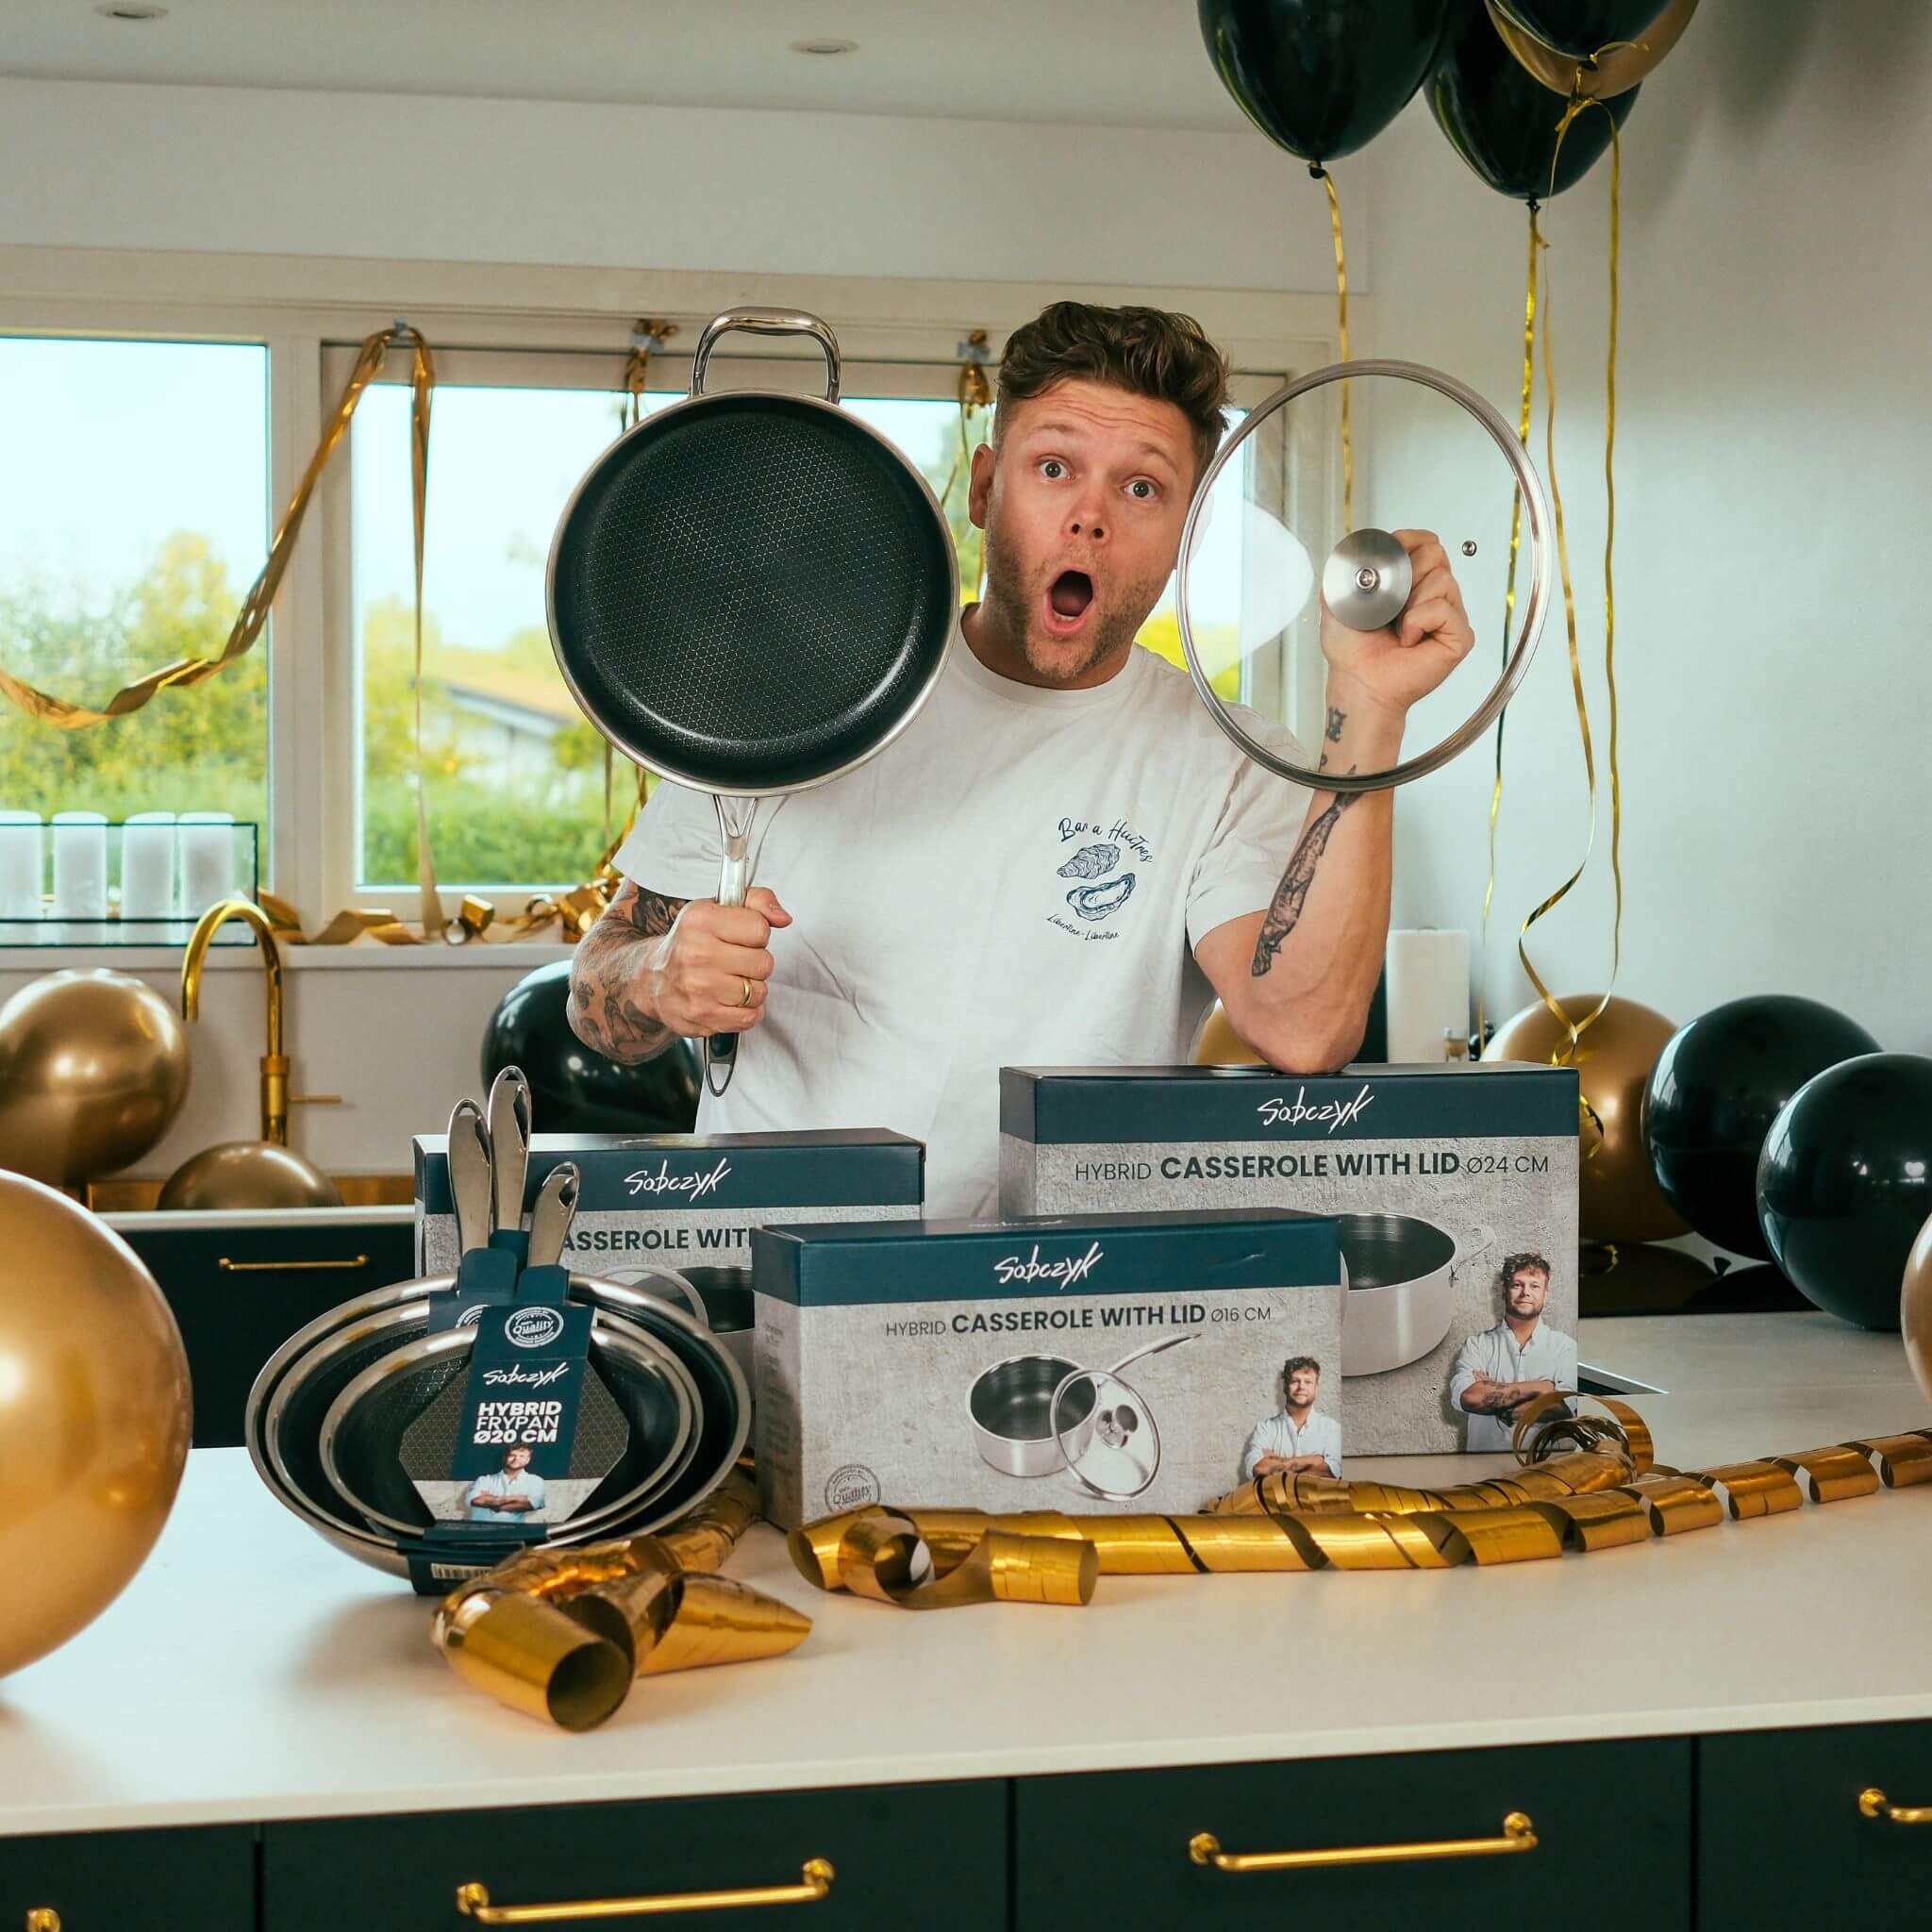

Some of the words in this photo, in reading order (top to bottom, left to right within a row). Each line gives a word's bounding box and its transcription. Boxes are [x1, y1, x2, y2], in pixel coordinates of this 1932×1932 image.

[1058, 817, 1088, 842] Bar
[1257, 1085, 1374, 1134] Sobczyk
[1075, 1163, 1152, 1180] HYBRID
[1160, 1154, 1328, 1179] CASSEROLE
[1335, 1153, 1410, 1176] WITH
[1419, 1152, 1459, 1174] LID
[1514, 1156, 1549, 1173] CM
[624, 1158, 732, 1203] Sobczyk
[563, 1229, 689, 1251] ASSEROLE
[993, 1241, 1104, 1291] Sobczyk
[886, 1320, 947, 1337] HYBRID
[951, 1308, 1093, 1334] CASSEROLE
[1100, 1306, 1164, 1327] WITH
[1171, 1304, 1207, 1324] LID
[1244, 1307, 1272, 1322] CM
[482, 1361, 570, 1390] Sobczyk
[475, 1415, 559, 1431] FRYPAN
[477, 1401, 563, 1417] HYBRID
[520, 1428, 558, 1443] CM
